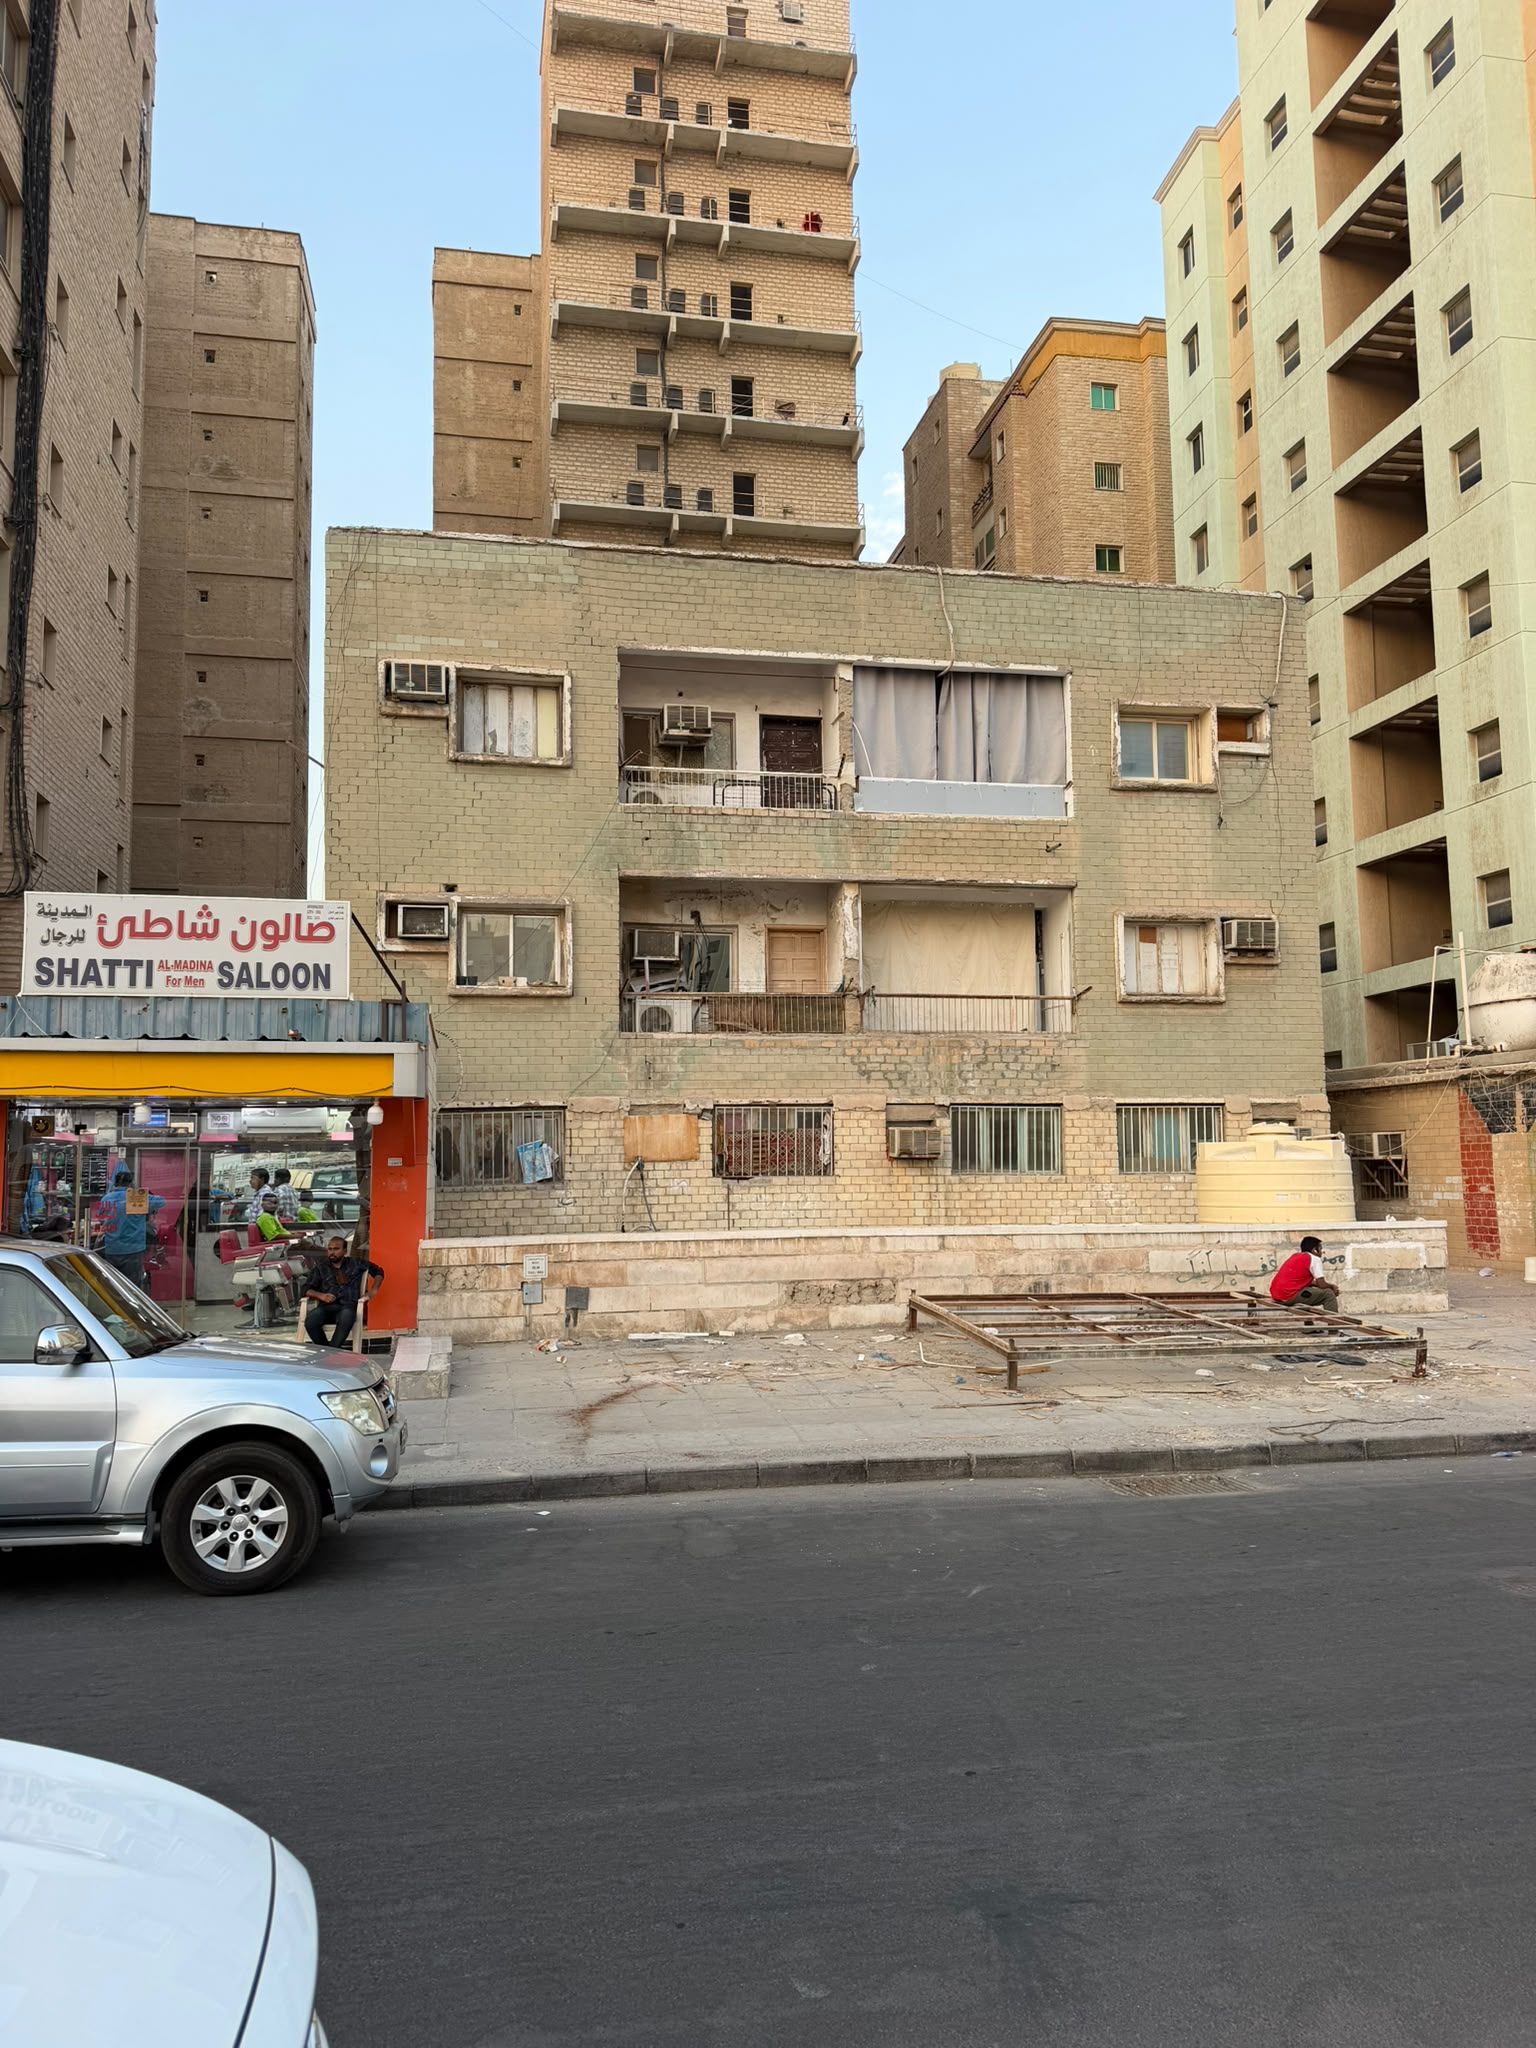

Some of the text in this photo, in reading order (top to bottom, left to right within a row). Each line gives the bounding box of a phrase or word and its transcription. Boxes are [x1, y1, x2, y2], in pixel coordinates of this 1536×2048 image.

[37, 902, 92, 921] المدينة
[40, 928, 86, 945] للرجال
[96, 903, 336, 951] صالون شاطئ
[35, 957, 154, 988] SHATTI
[157, 959, 214, 972] AL-MADINA
[217, 960, 331, 990] SALOON
[165, 976, 205, 987] For Men
